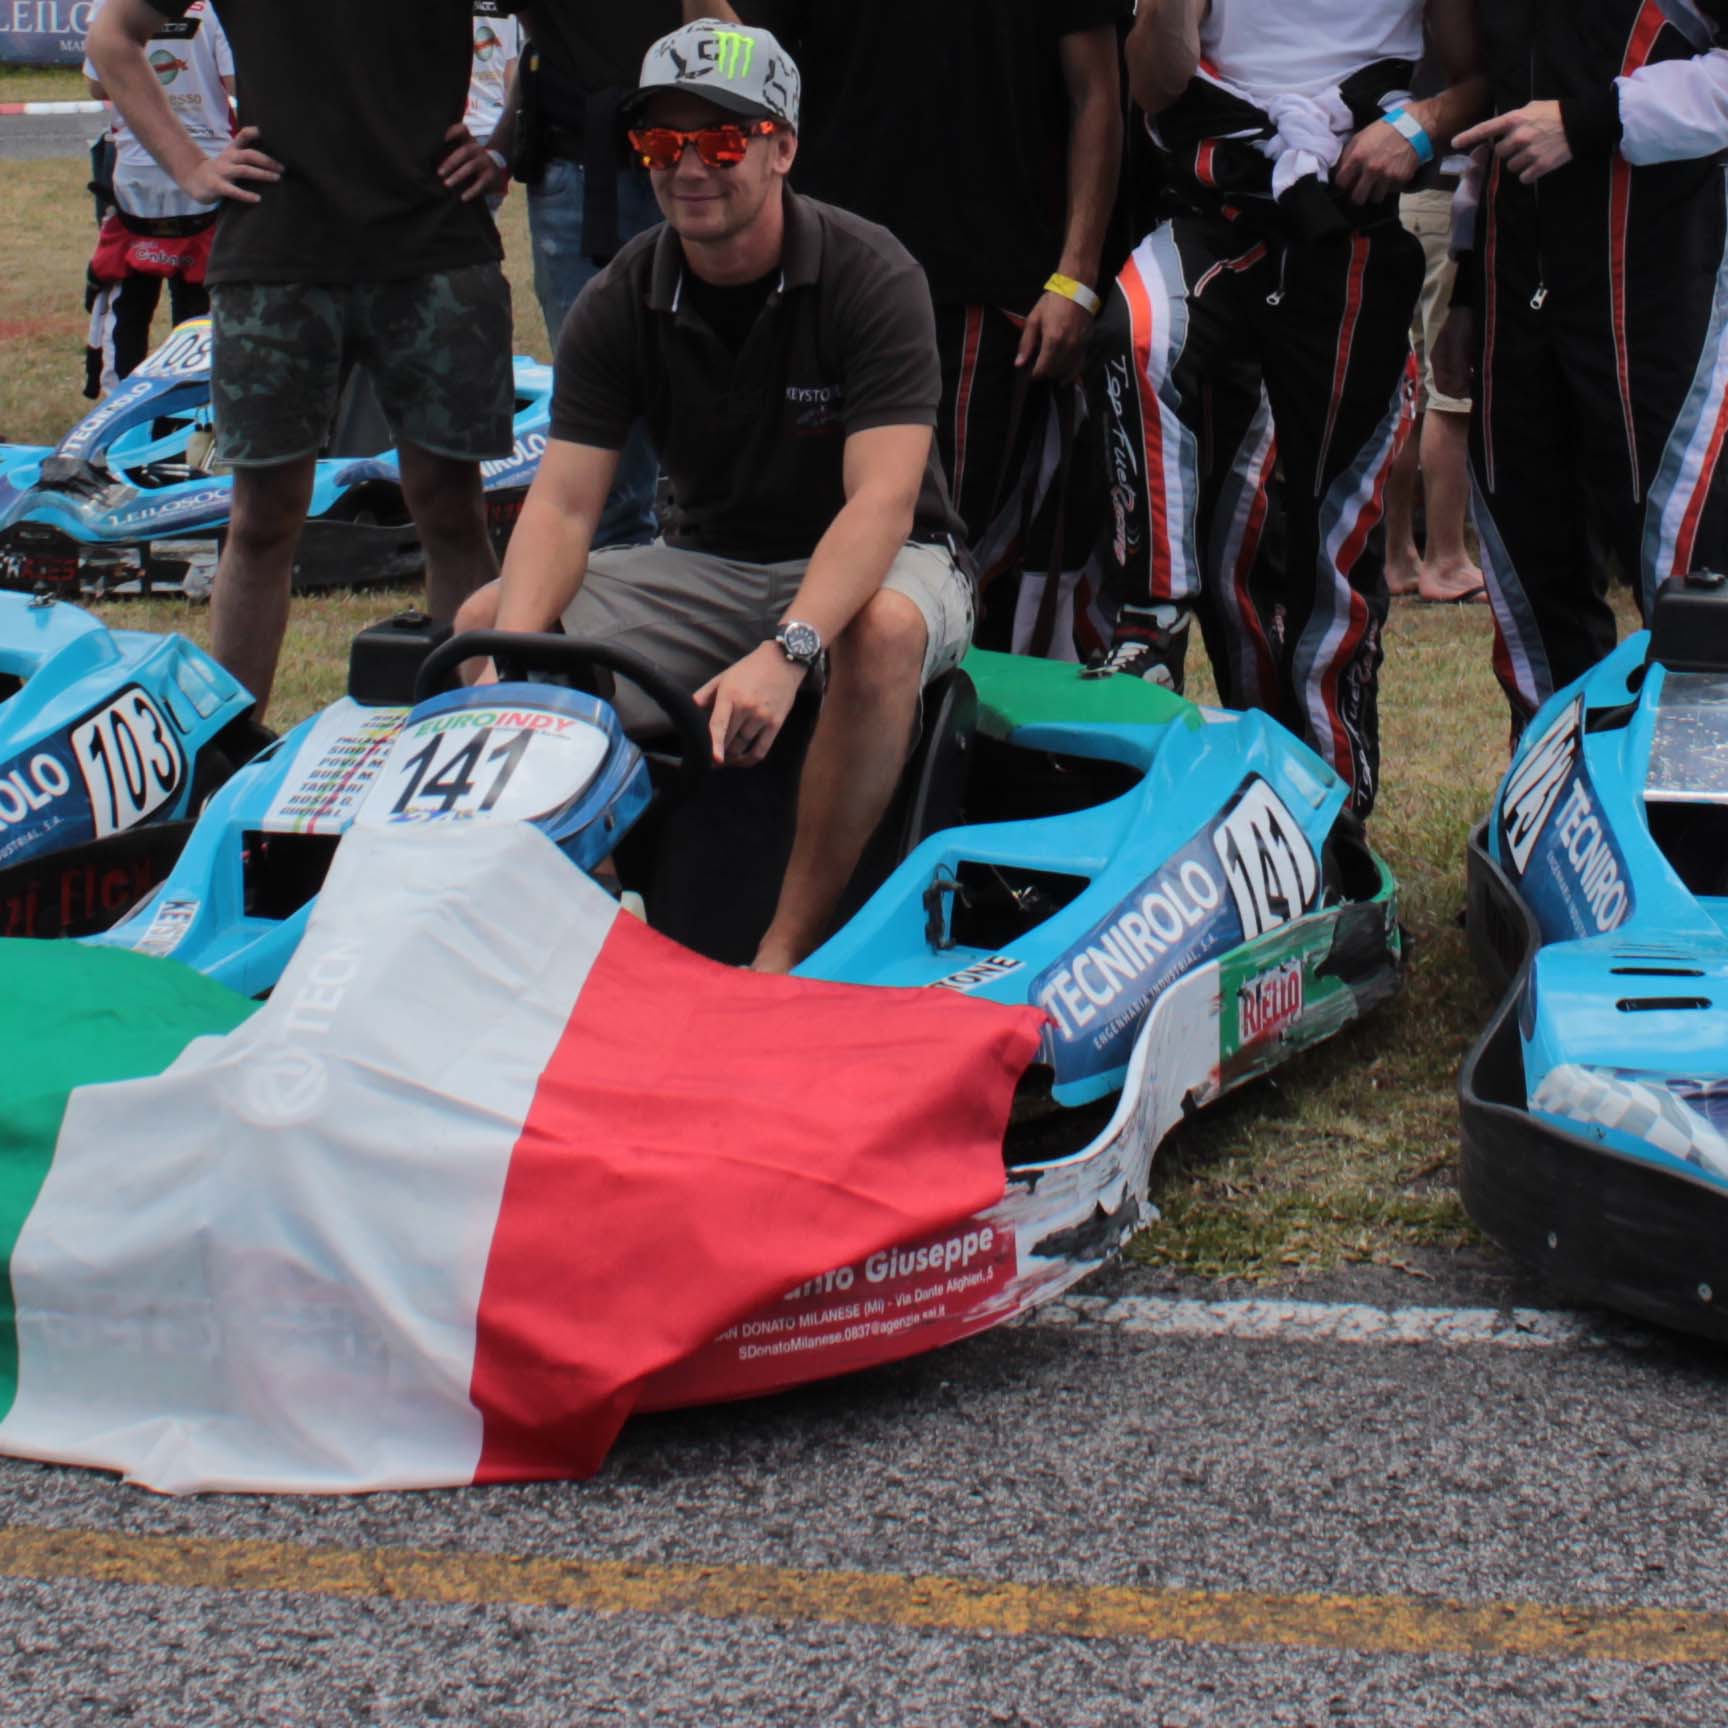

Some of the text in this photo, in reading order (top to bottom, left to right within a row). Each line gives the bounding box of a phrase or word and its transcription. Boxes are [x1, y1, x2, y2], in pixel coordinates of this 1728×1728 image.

[415, 711, 576, 738] EUROINDY
[390, 726, 535, 814] 141
[1040, 860, 1219, 1041] TECNIROLO
[865, 1227, 994, 1283] Giuseppe
[742, 1317, 796, 1339] DONATO
[799, 1303, 861, 1329] MILANESE
[896, 1291, 912, 1307] Via
[914, 1284, 944, 1302] Dante
